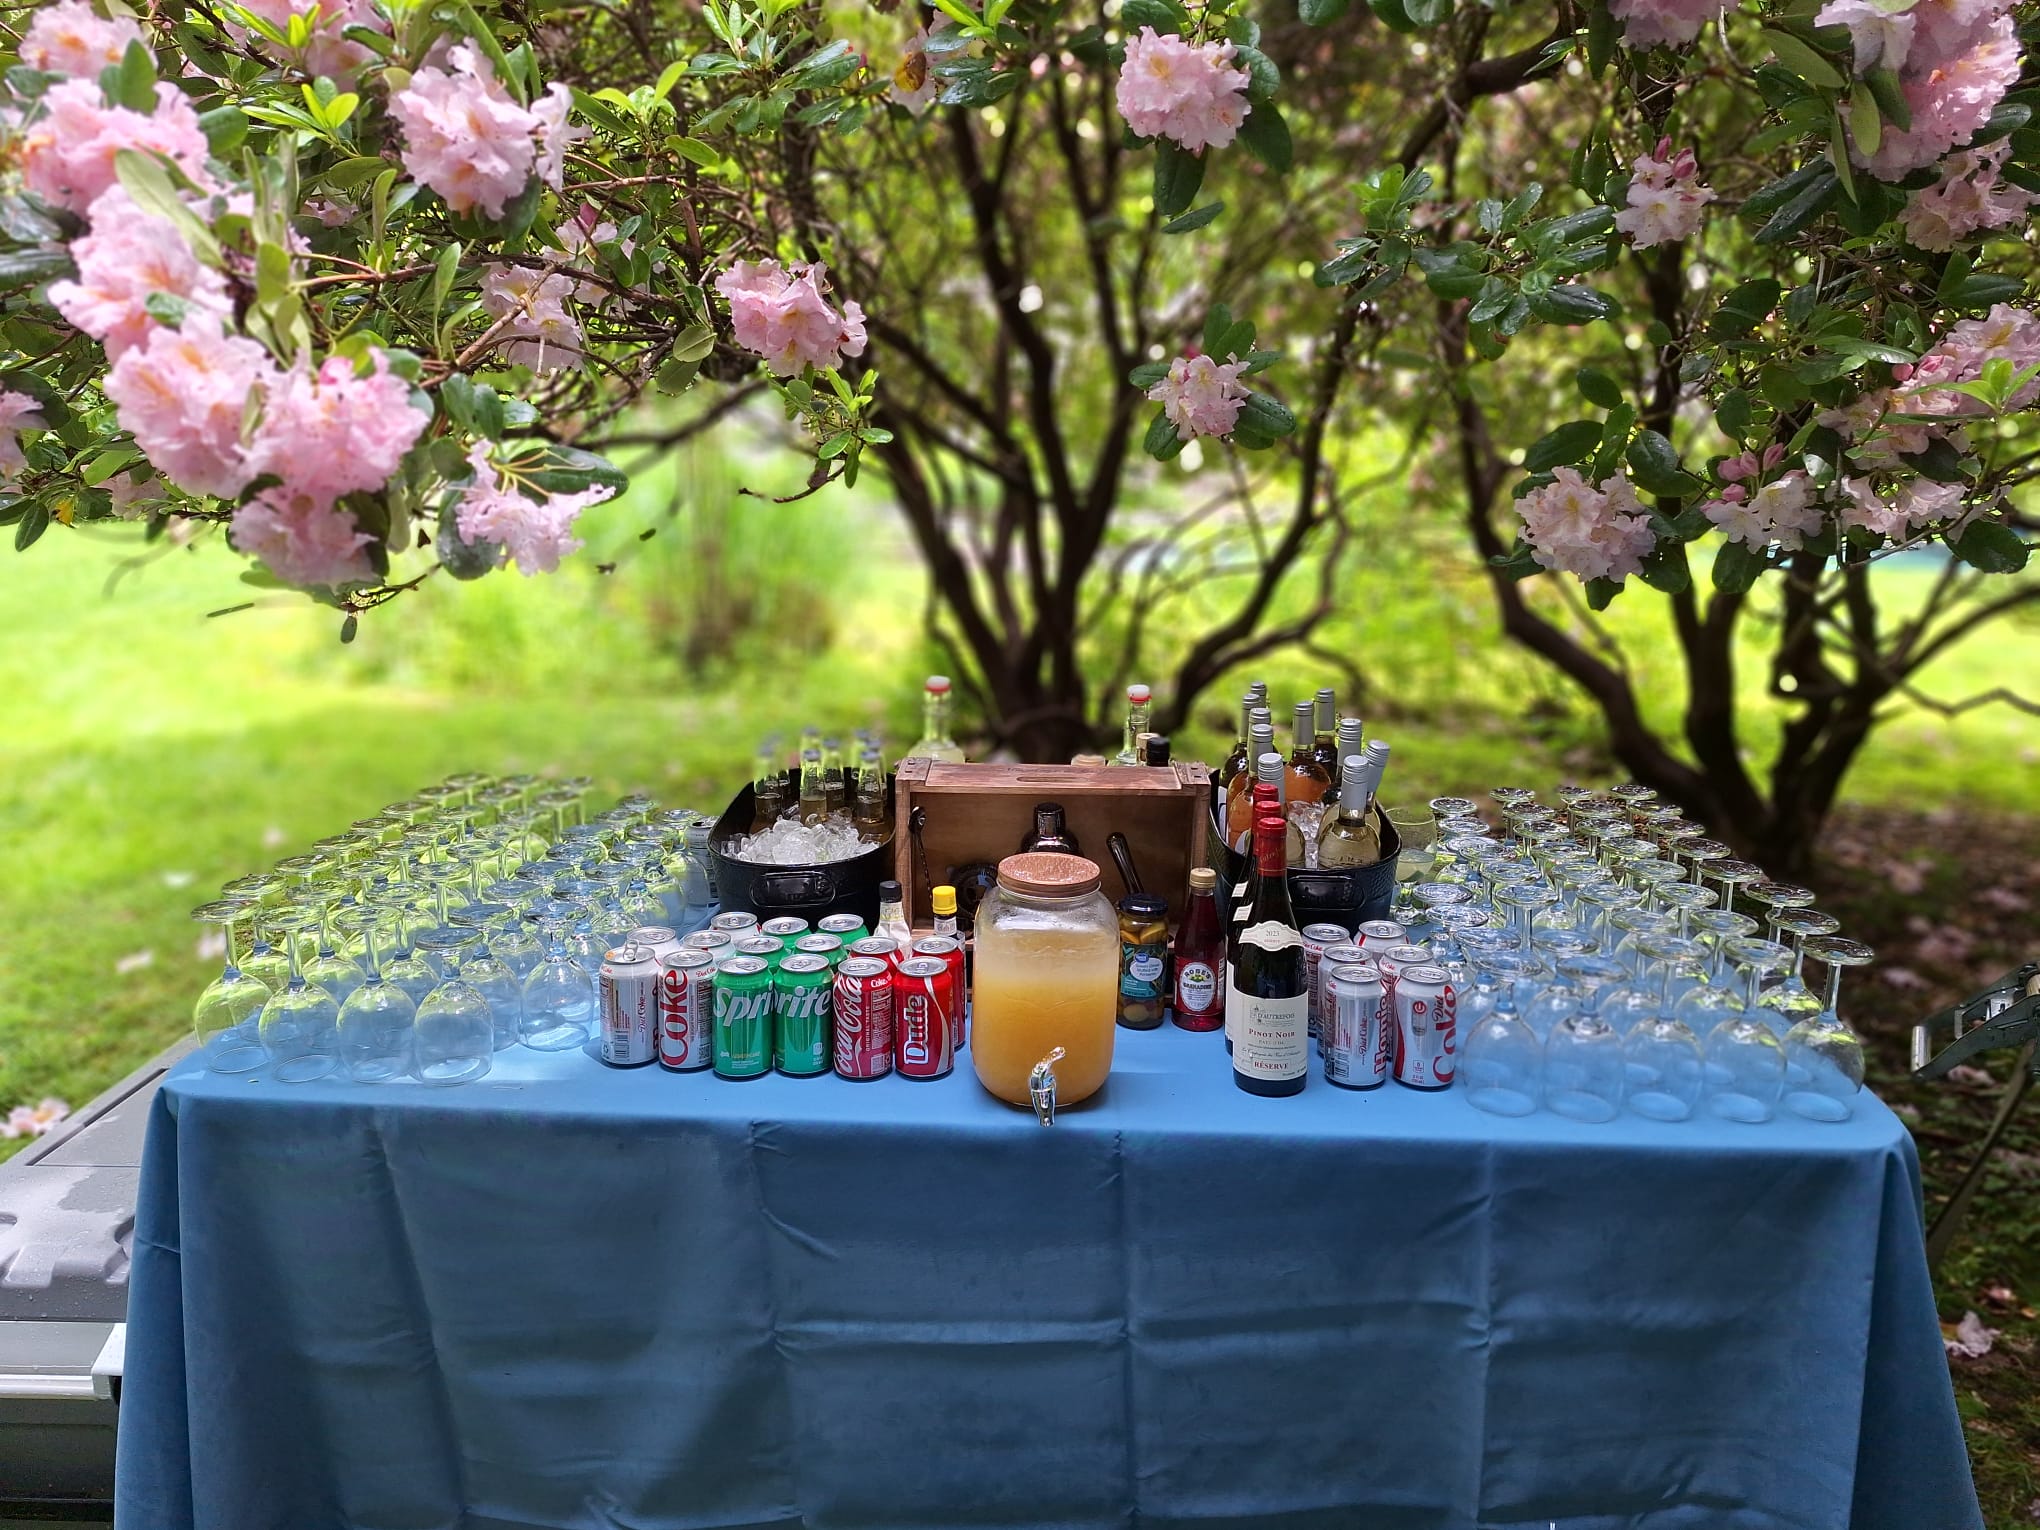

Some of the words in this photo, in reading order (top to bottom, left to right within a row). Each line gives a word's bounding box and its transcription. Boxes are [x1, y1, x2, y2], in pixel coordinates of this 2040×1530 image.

[871, 978, 887, 988] Coke
[1184, 969, 1211, 980] ROSE'S
[713, 979, 774, 1027] Spri
[1431, 994, 1444, 1021] Diet
[660, 969, 689, 1066] Coke
[1359, 1016, 1368, 1036] Coke
[903, 994, 929, 1065] Dude
[1249, 1028, 1273, 1038] PINOT
[1276, 1031, 1295, 1039] NOIR
[1374, 996, 1388, 1074] Homie
[1433, 985, 1457, 1083] Coke
[1359, 1036, 1368, 1055] Diet
[1254, 1060, 1289, 1070] RÉSERVE
